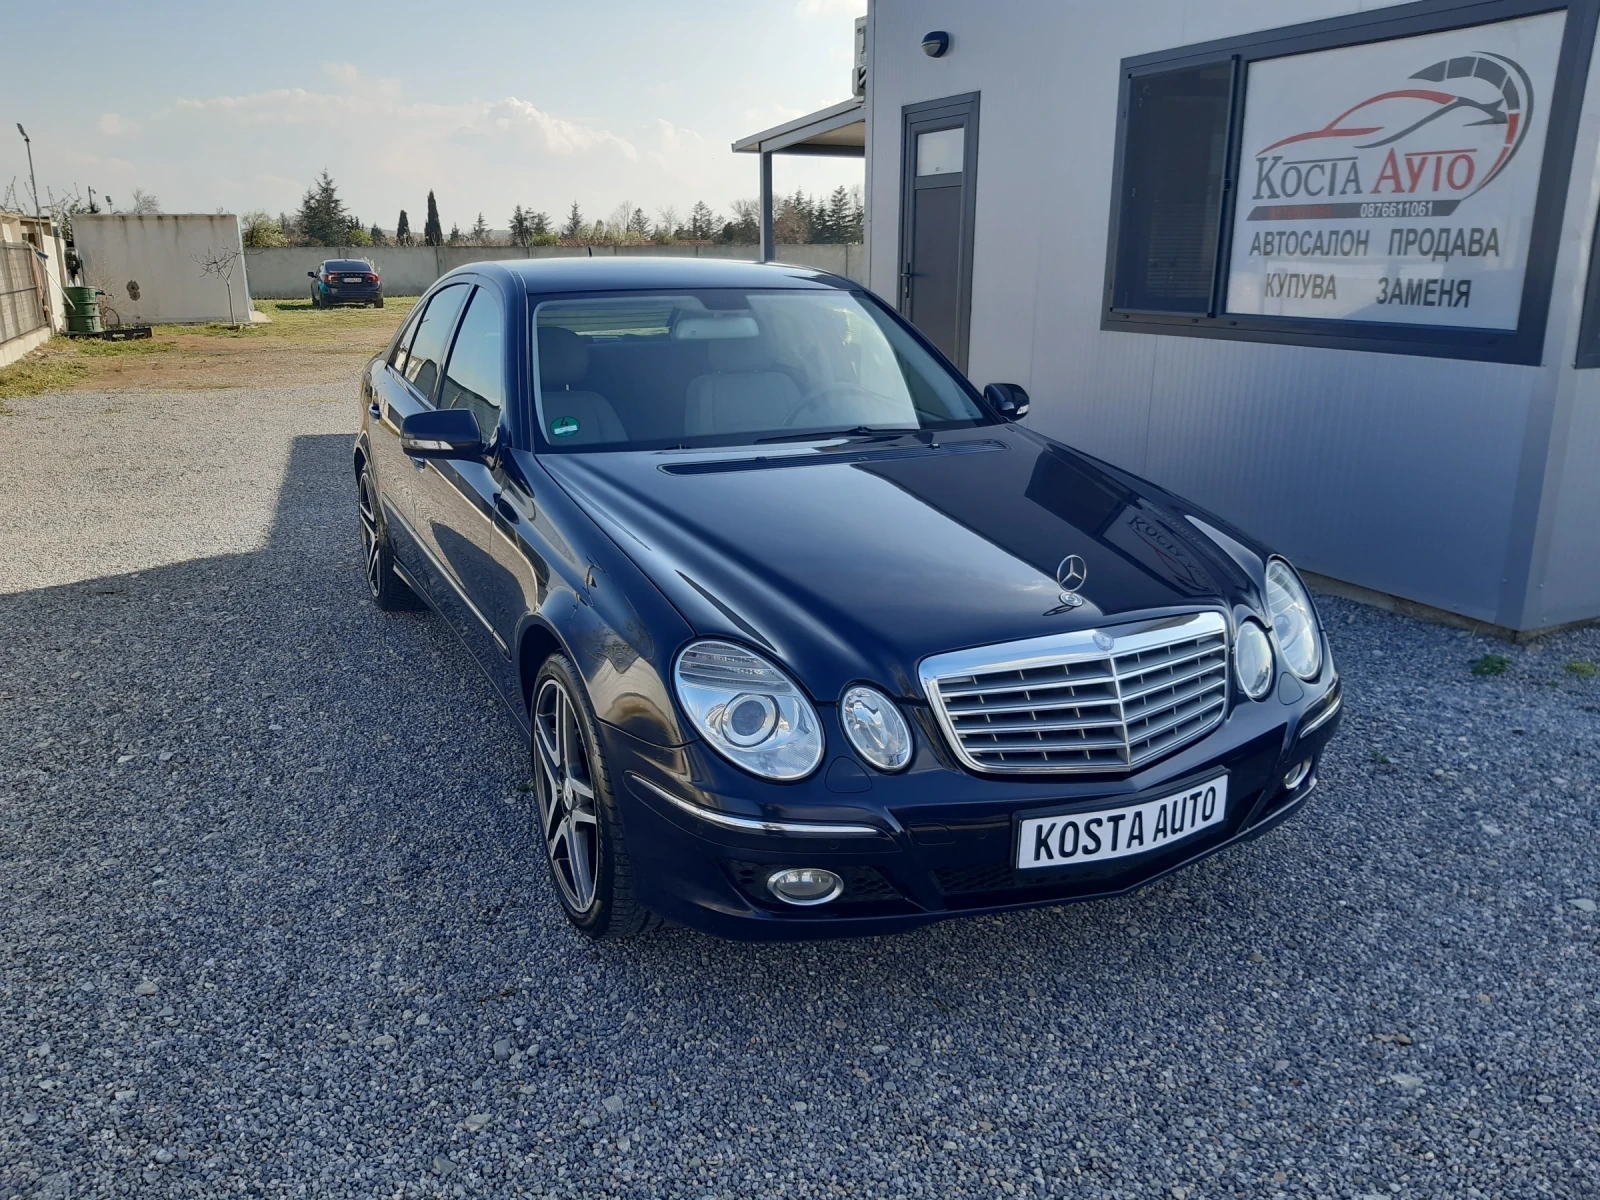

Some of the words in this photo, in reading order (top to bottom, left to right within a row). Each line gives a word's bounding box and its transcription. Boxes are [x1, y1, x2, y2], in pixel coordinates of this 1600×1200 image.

[1360, 201, 1433, 217] 0876611061
[1249, 230, 1370, 257] АВТОСАЛОН
[1388, 228, 1500, 262] ПРОДАВА
[1264, 273, 1337, 300] КУПУВА
[1376, 277, 1472, 308] ЗАМЕНЯ
[1033, 810, 1144, 861] KOSTA
[1152, 786, 1217, 843] AUTO
